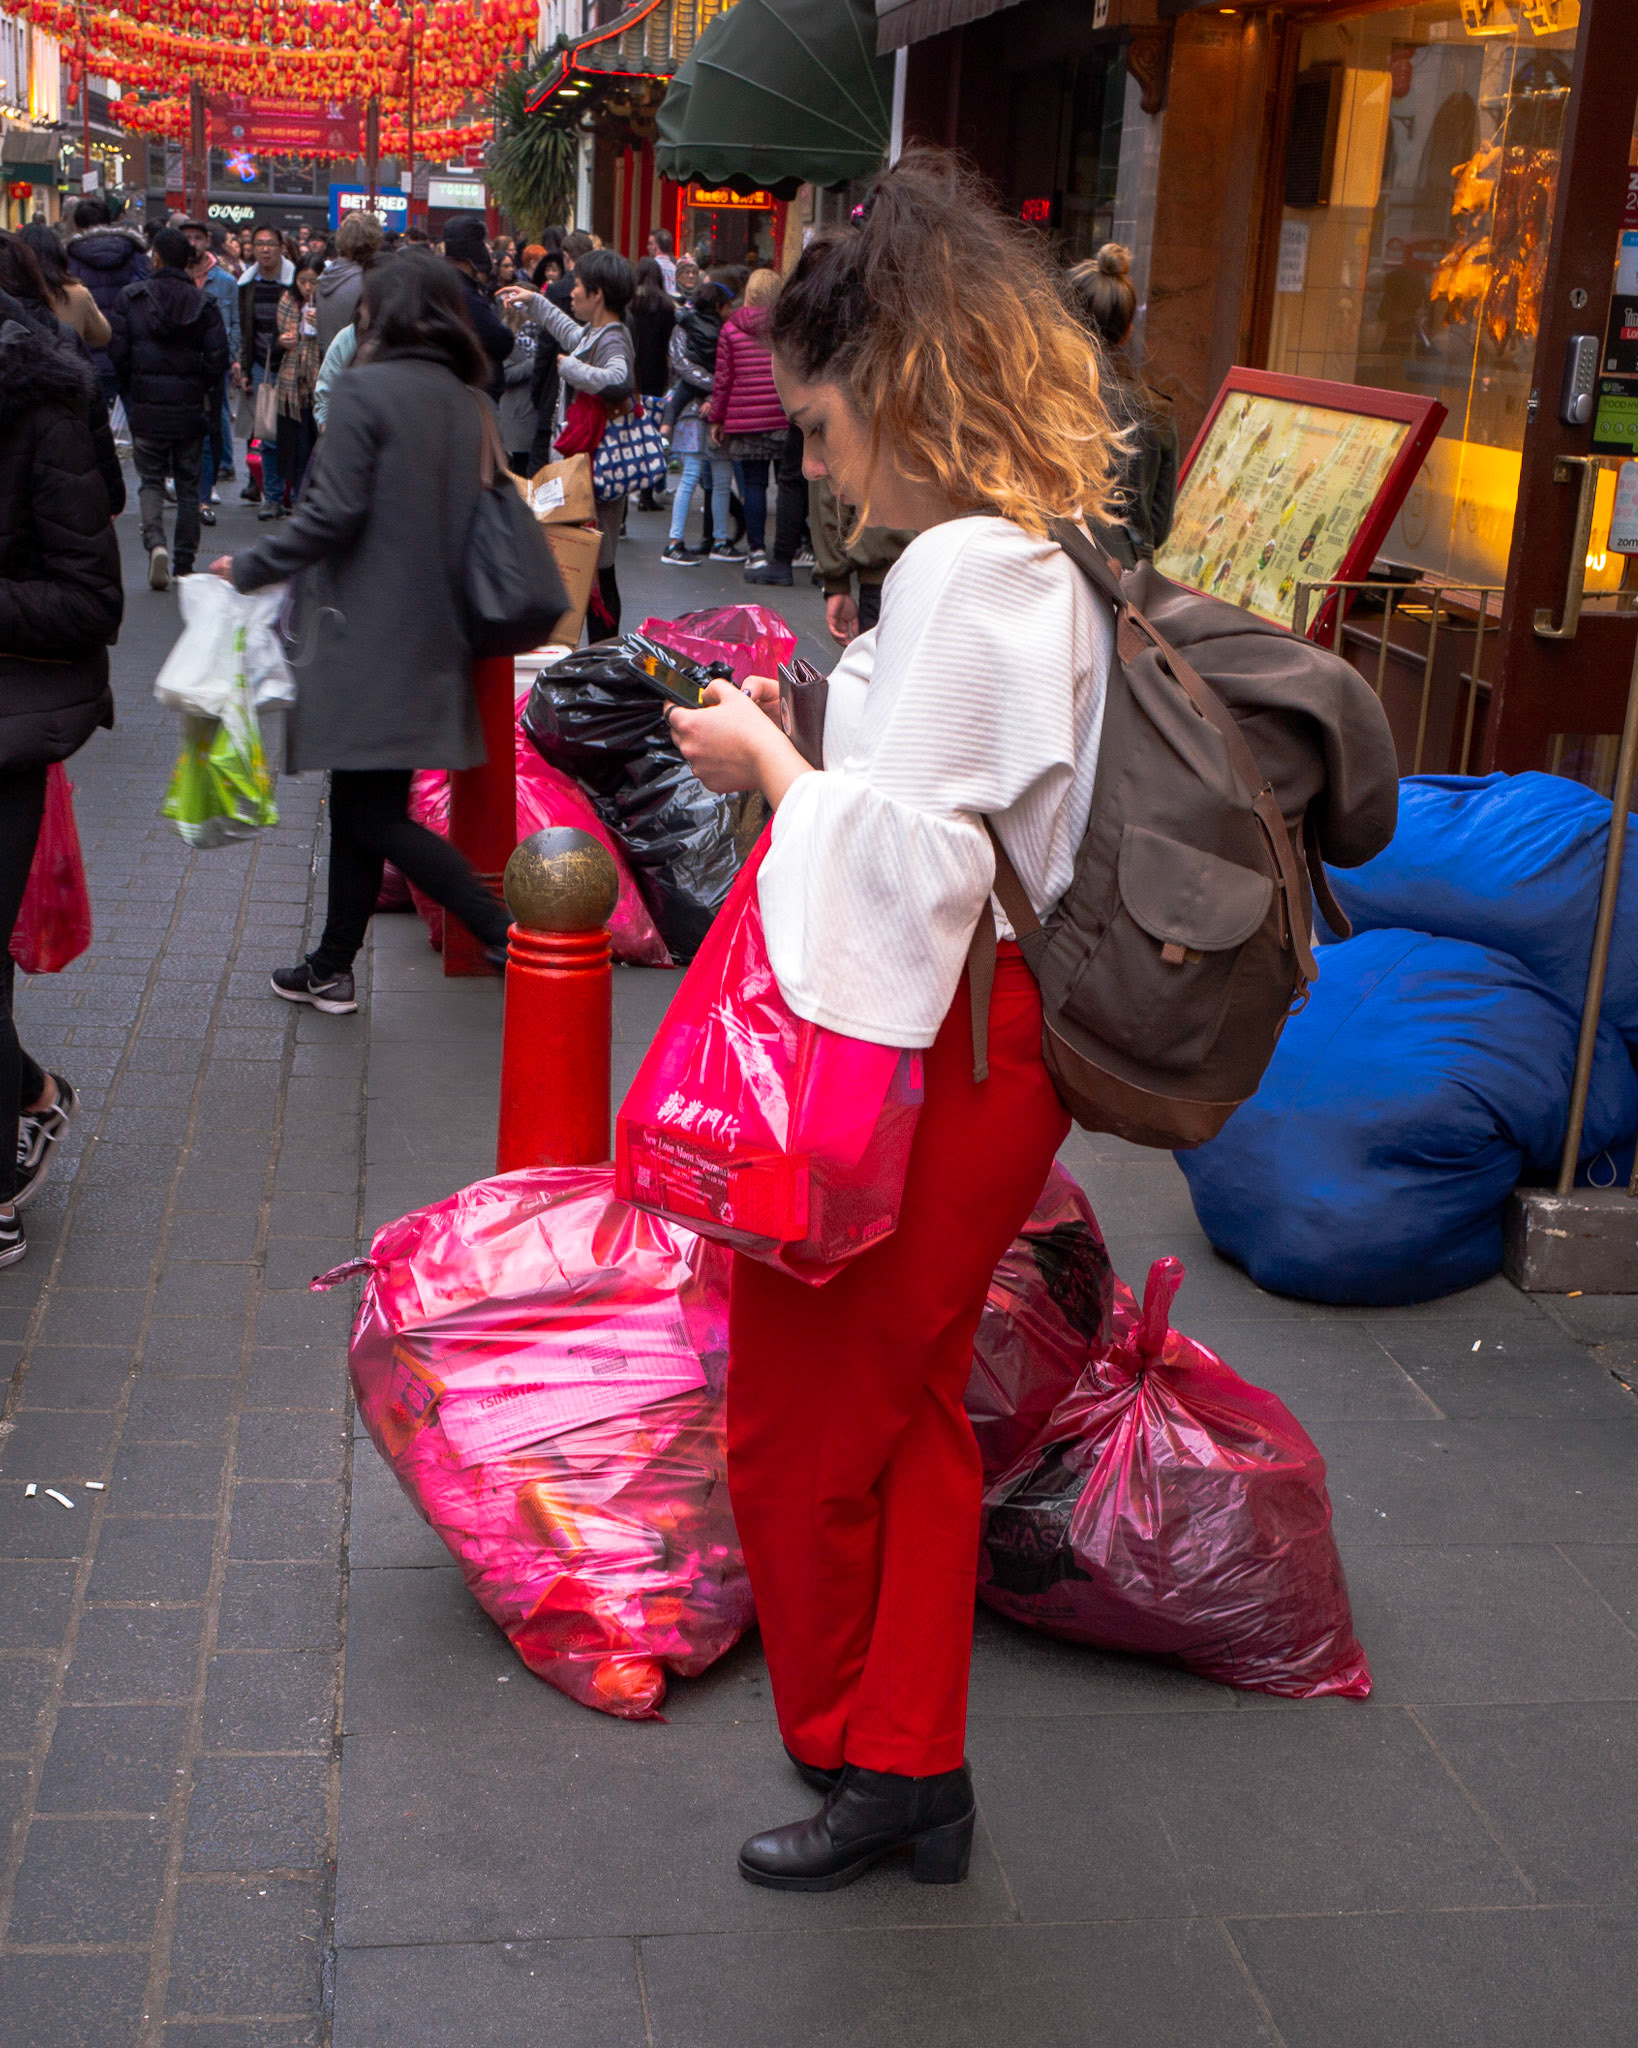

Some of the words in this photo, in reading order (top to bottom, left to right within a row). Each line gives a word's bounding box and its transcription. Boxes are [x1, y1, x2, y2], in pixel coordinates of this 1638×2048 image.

[340, 193, 408, 212] BETRED
[1022, 199, 1050, 220] OPEN
[643, 1130, 657, 1146] New
[676, 1144, 695, 1164] Moon
[696, 1154, 739, 1182] Supermarket
[994, 1524, 1058, 1554] WAS
